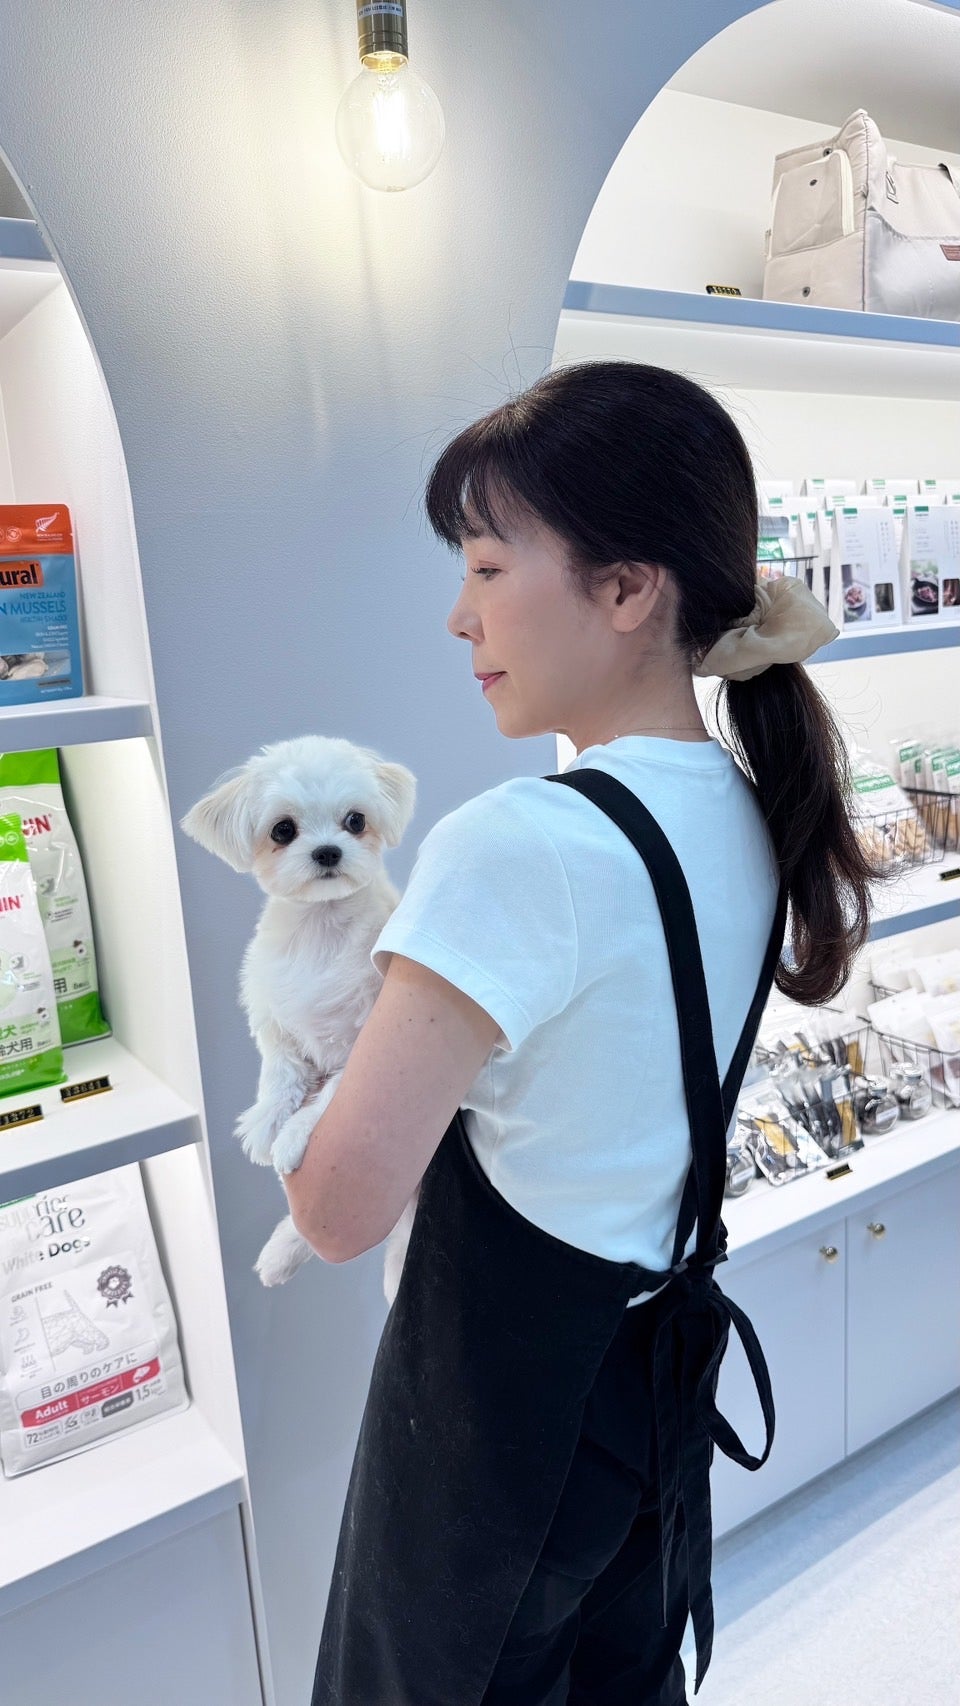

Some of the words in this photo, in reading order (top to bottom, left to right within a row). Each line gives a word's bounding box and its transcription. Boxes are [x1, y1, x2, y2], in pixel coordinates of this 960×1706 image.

[20, 592, 37, 600] NEW
[38, 591, 66, 599] ZEALAND
[10, 600, 67, 616] MUSSELS
[26, 1207, 86, 1242] care
[34, 1281, 53, 1294] FREE
[40, 1352, 138, 1399] 目の周りのケアに
[80, 1383, 121, 1404] サーモン
[35, 1399, 69, 1419] Adult
[26, 1432, 39, 1445] 72
